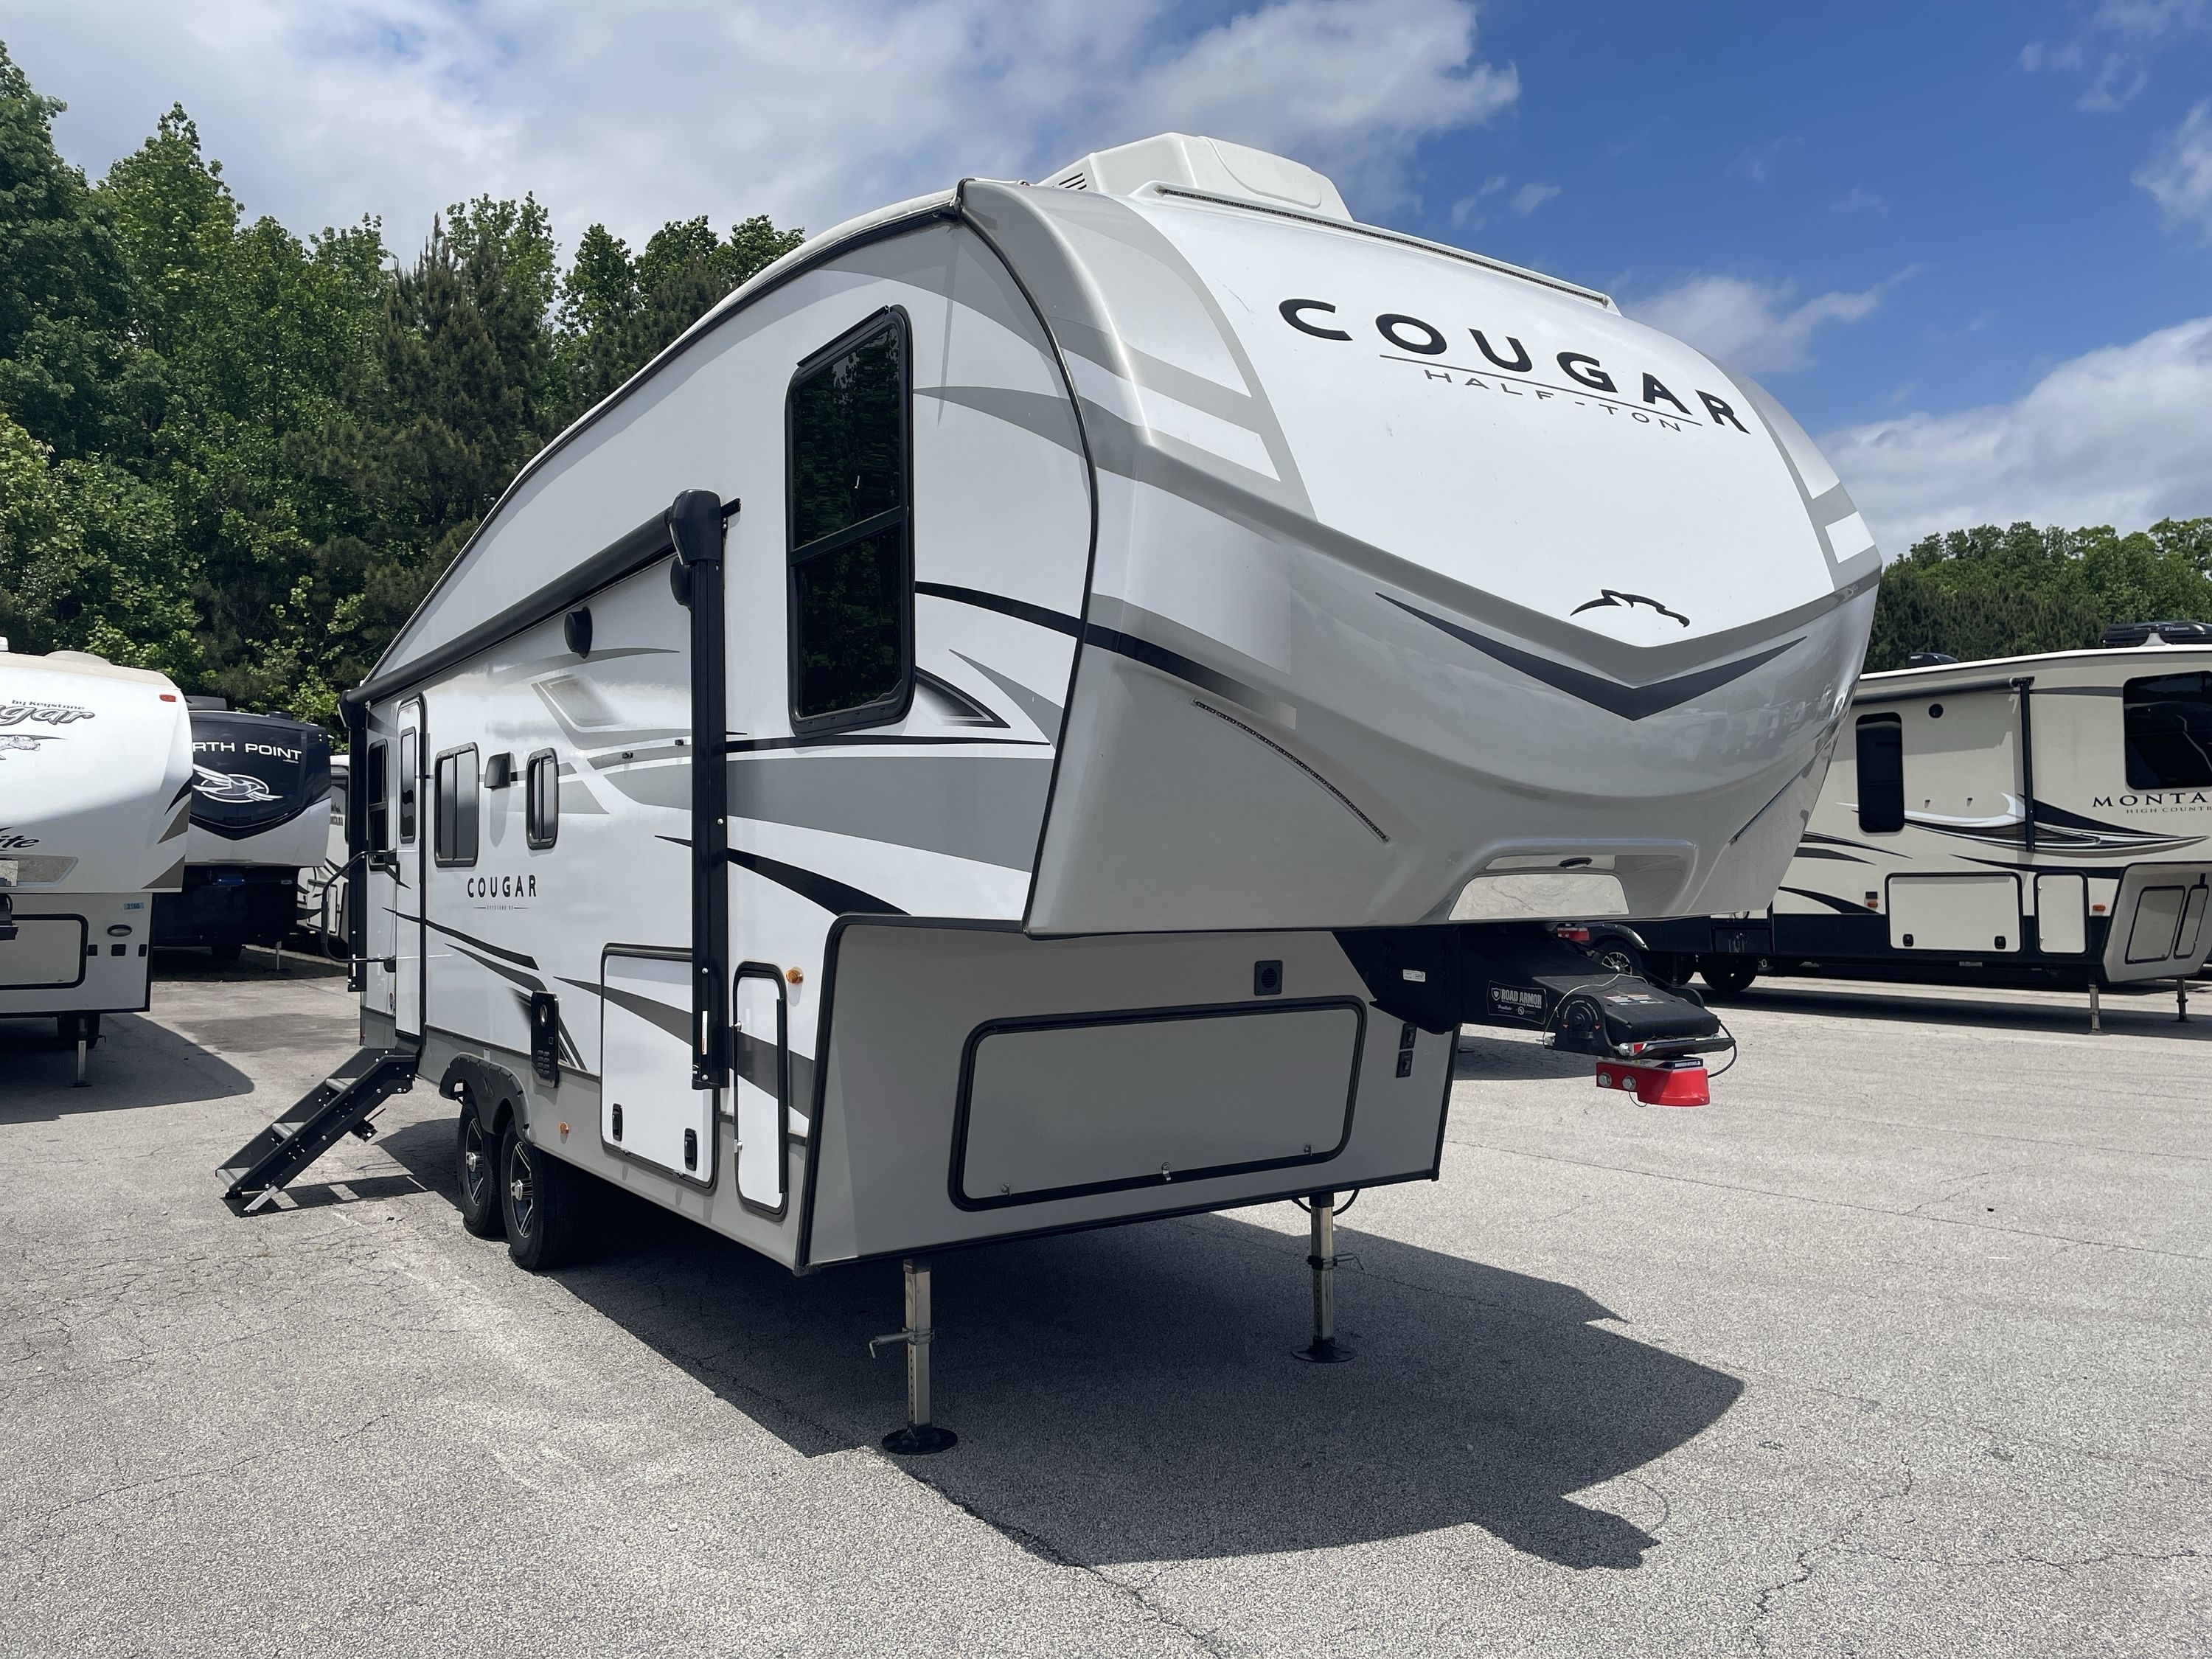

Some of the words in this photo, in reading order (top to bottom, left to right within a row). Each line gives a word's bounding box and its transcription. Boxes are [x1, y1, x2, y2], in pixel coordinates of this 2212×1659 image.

[1279, 298, 1751, 435] COUGAR
[29, 700, 86, 710] Keystone
[0, 705, 95, 726] gar
[192, 742, 235, 752] RTH
[245, 742, 302, 760] POINT
[2092, 791, 2209, 808] MONTA
[0, 834, 40, 849] ite
[467, 874, 537, 898] COUGAR
[1501, 988, 1519, 1002] ROAD
[1519, 991, 1543, 1006] ARMOR
